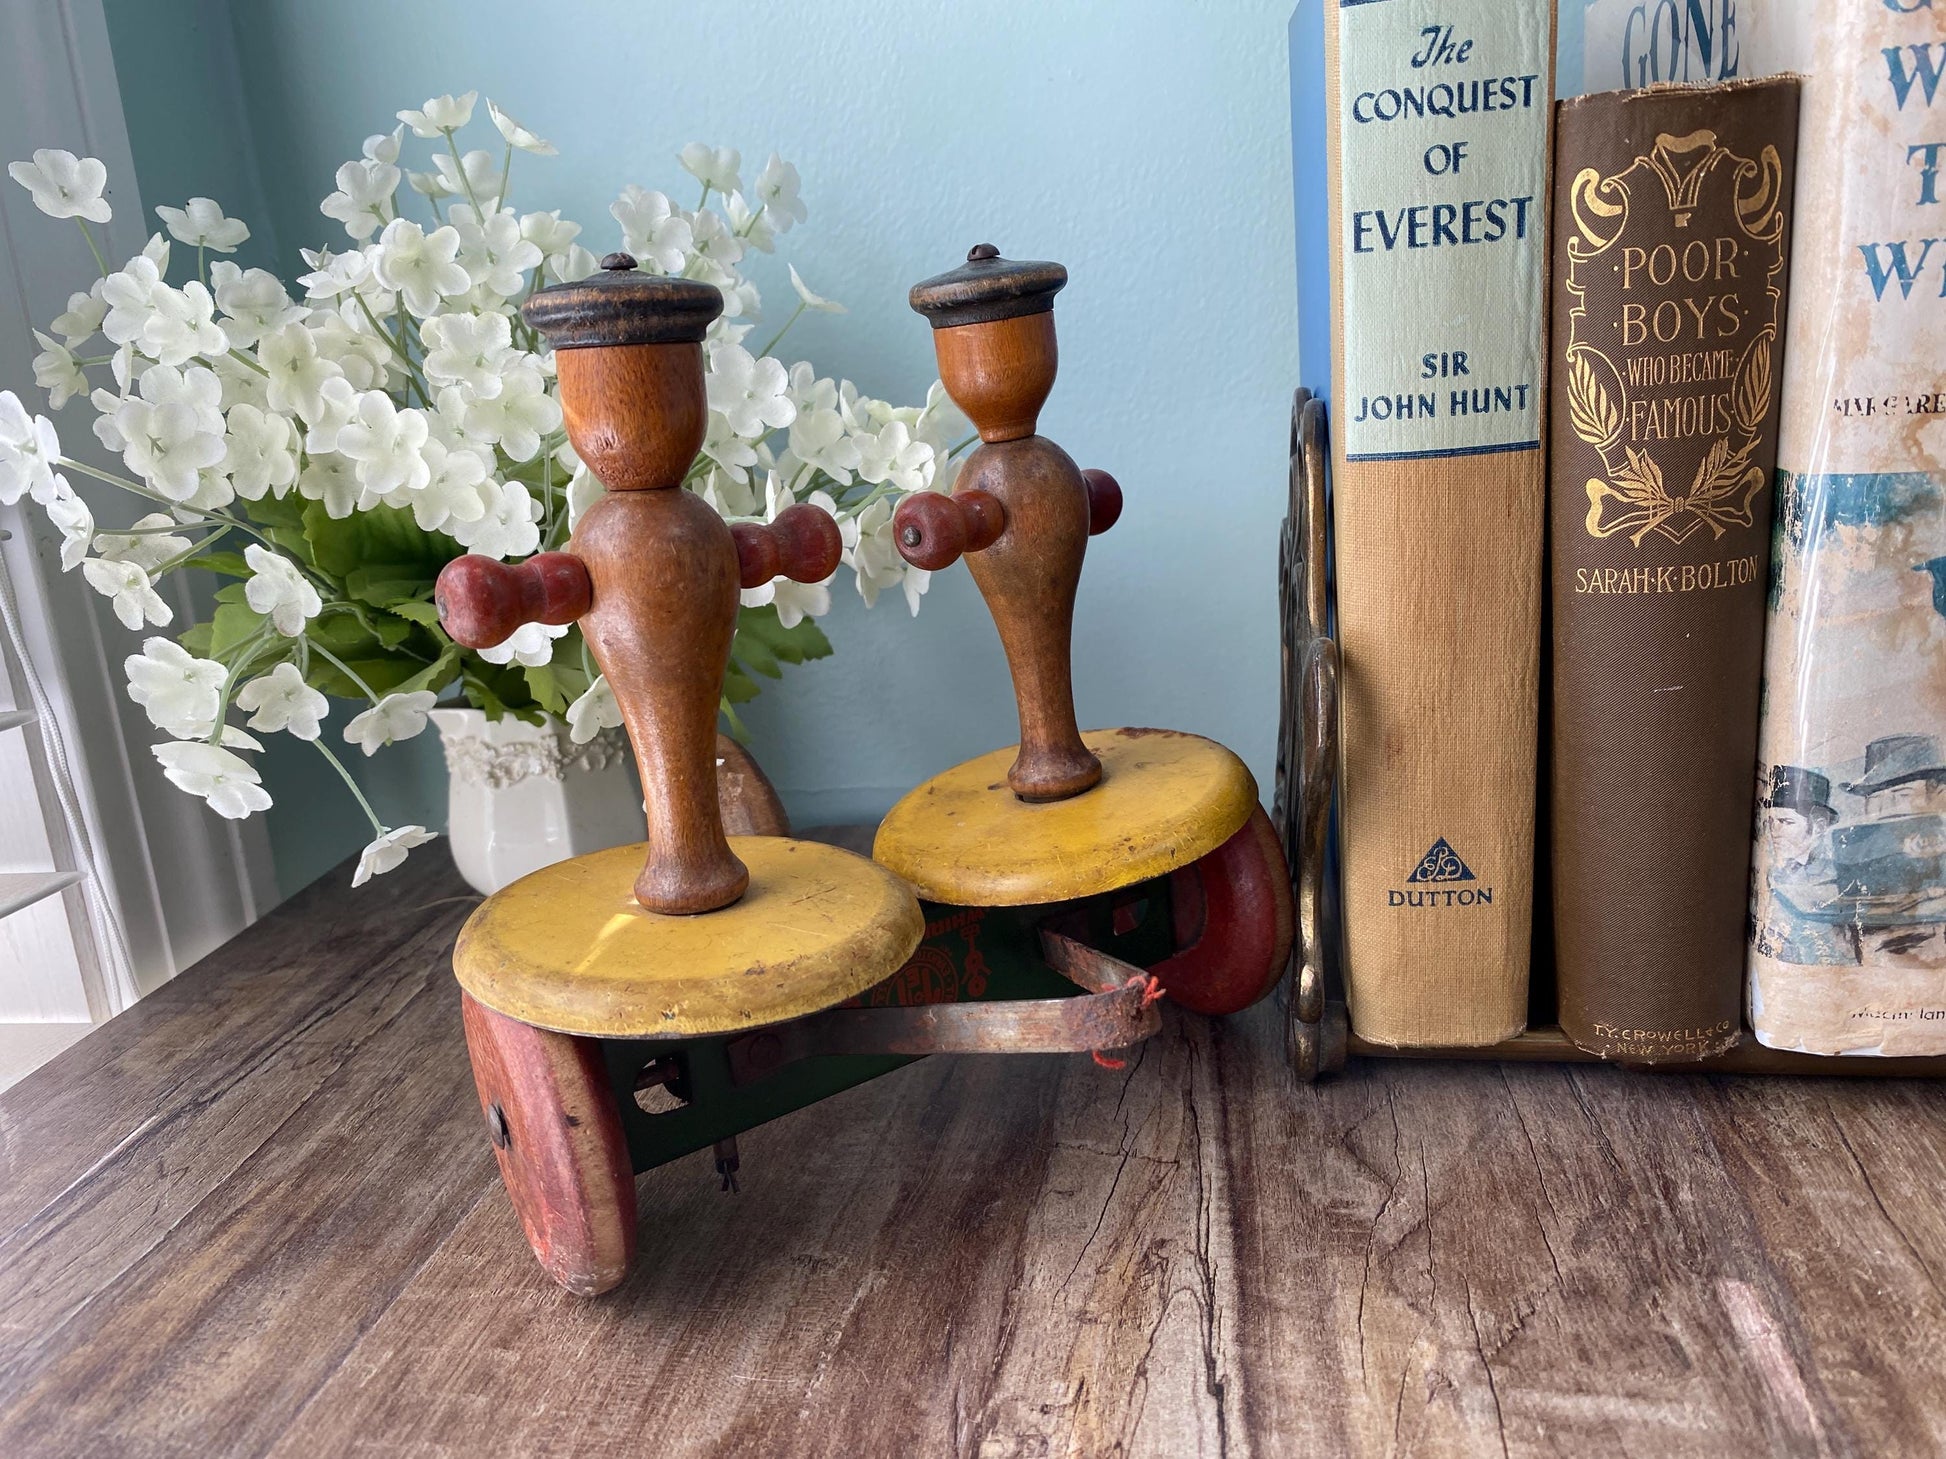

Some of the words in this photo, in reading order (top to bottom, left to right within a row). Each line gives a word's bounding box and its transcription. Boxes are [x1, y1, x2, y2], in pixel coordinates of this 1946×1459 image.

[1410, 24, 1474, 69] The
[1621, 0, 1740, 89] GONE
[1352, 74, 1539, 124] CONQUEST
[1423, 141, 1469, 176] OF
[1352, 195, 1534, 254] EVEREST
[1621, 236, 1741, 290] POOR
[1622, 293, 1740, 347] BOYS
[1420, 350, 1471, 380] SIR
[1626, 355, 1665, 387] WHO
[1669, 349, 1735, 384] BECAME
[1353, 391, 1436, 423] JOHN
[1450, 383, 1530, 417] HUNT
[1631, 393, 1732, 442] FAMOUS
[1387, 886, 1494, 908] DUTTON
[1617, 1042, 1656, 1056] NEW
[1662, 1040, 1710, 1056] YORK
